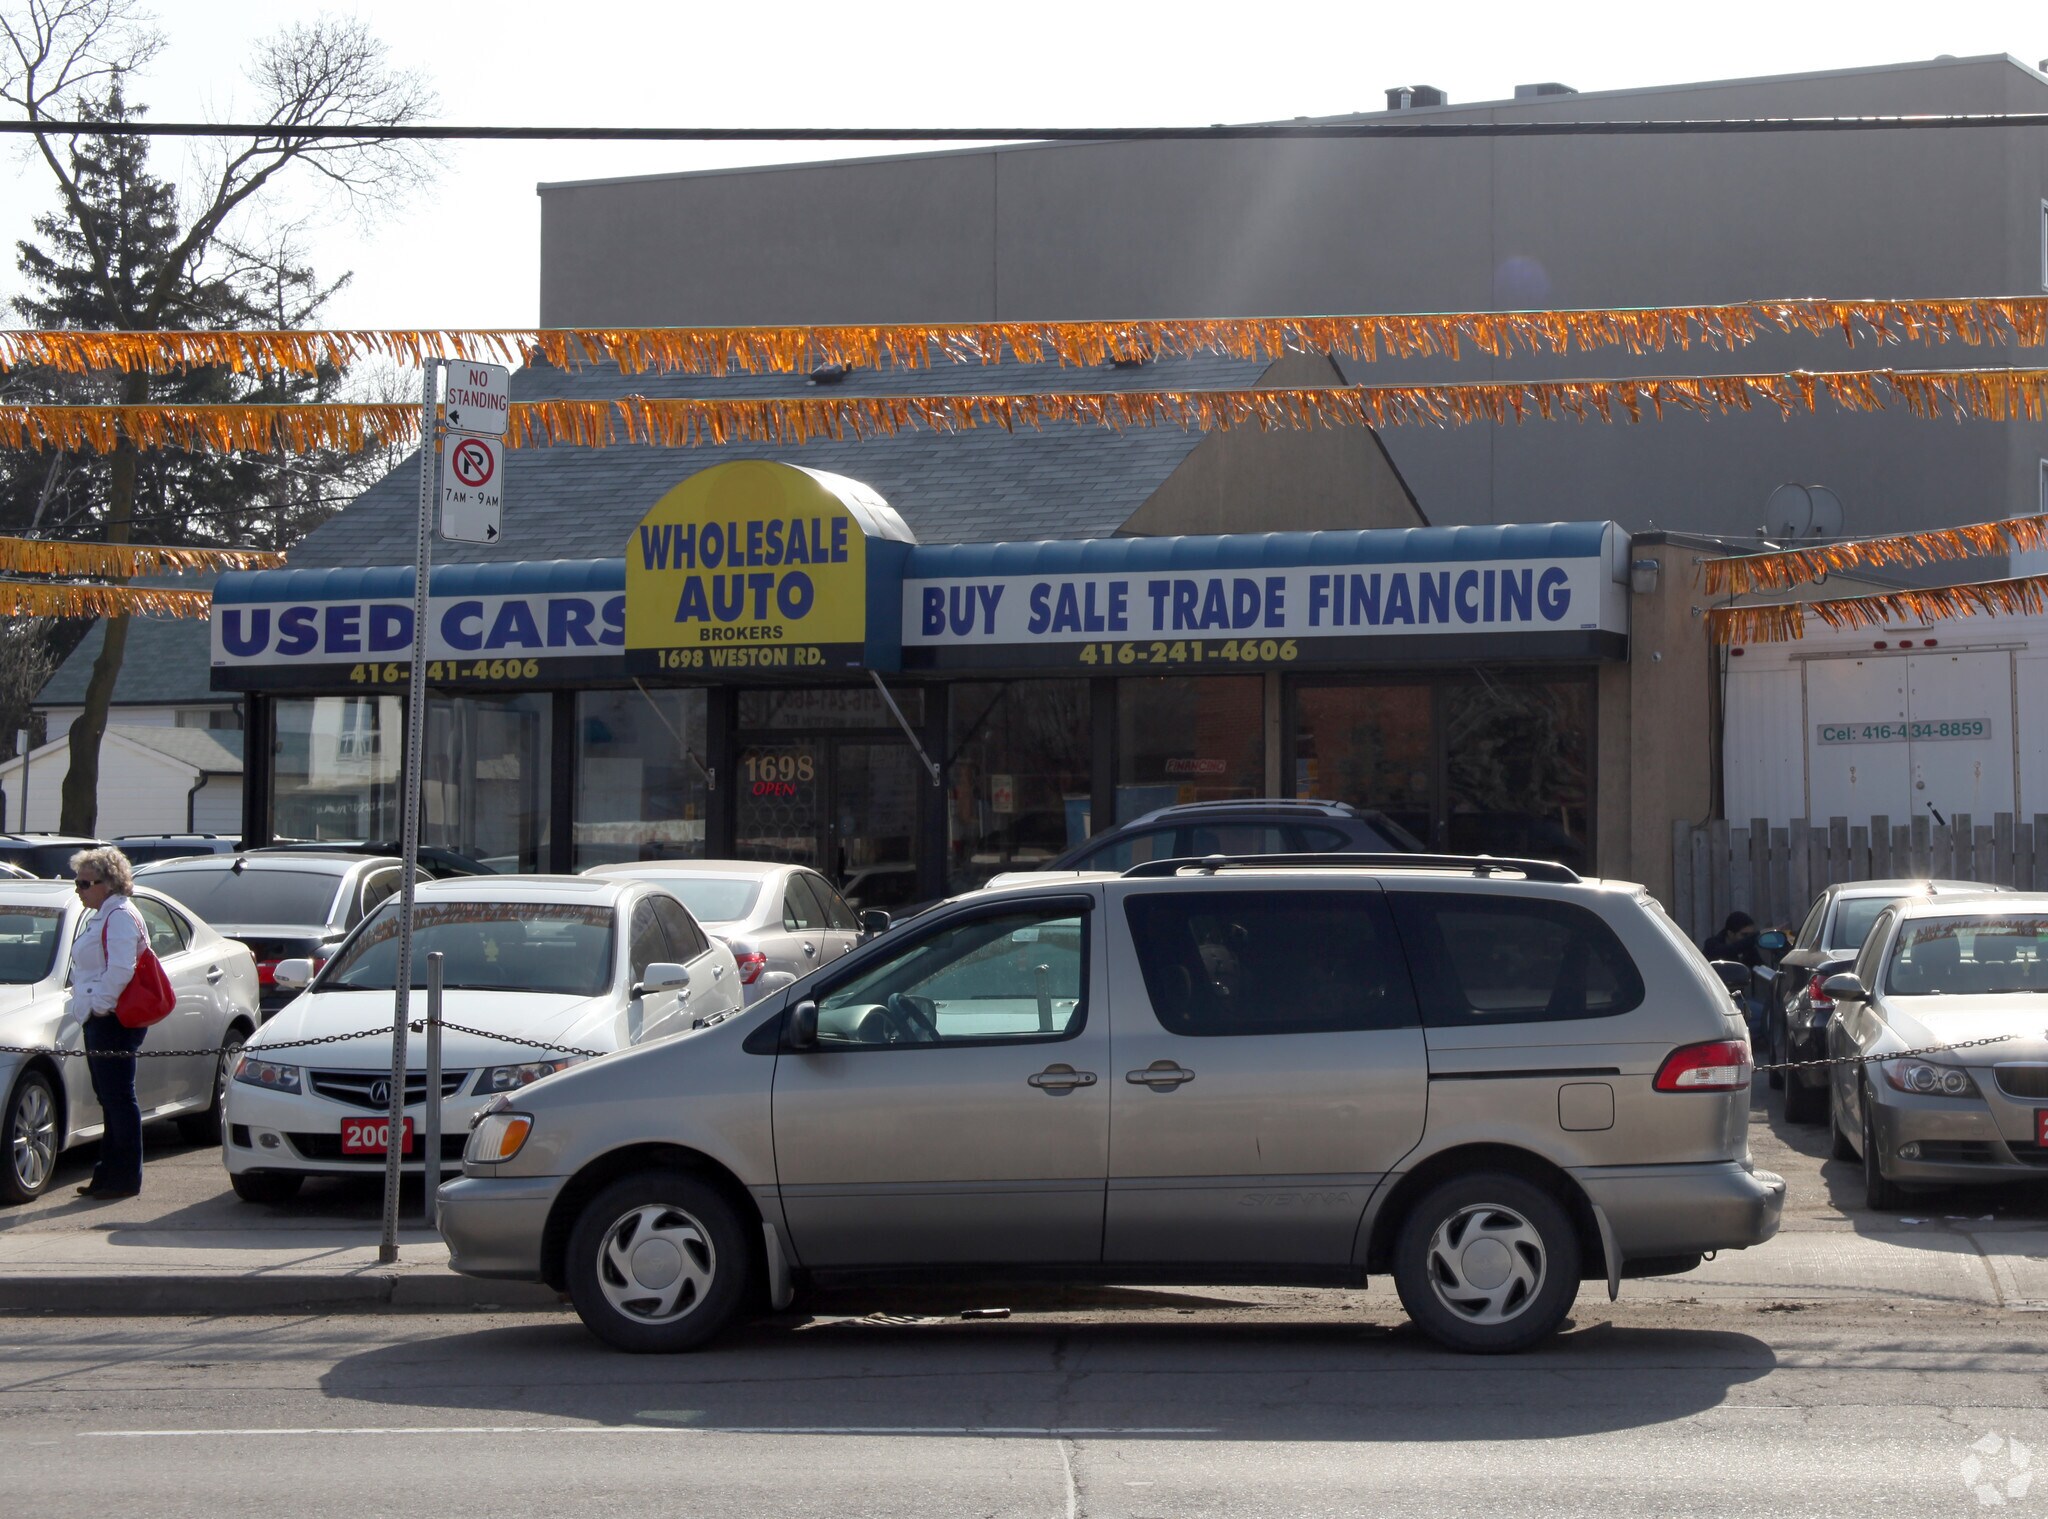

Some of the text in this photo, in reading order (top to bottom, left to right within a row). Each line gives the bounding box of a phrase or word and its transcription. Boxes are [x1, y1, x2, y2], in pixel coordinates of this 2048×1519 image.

[469, 369, 488, 387] NO
[448, 388, 507, 411] STANDING
[640, 517, 848, 570] WHOLESALE
[674, 571, 814, 623] AUTO
[922, 566, 1571, 636] BUY SALE TRADE FINANCING
[221, 595, 625, 657] USED CARS
[699, 625, 783, 641] BROKERS
[658, 647, 826, 668] 1698 WESTON RD.
[1079, 639, 1298, 665] 416-241-4606
[350, 658, 539, 683] 416-41-4606
[1823, 721, 1983, 741] Cel: 416-434-8859
[745, 755, 815, 781] 1698
[1166, 759, 1226, 773] FINANCING
[752, 781, 798, 796] OPEN
